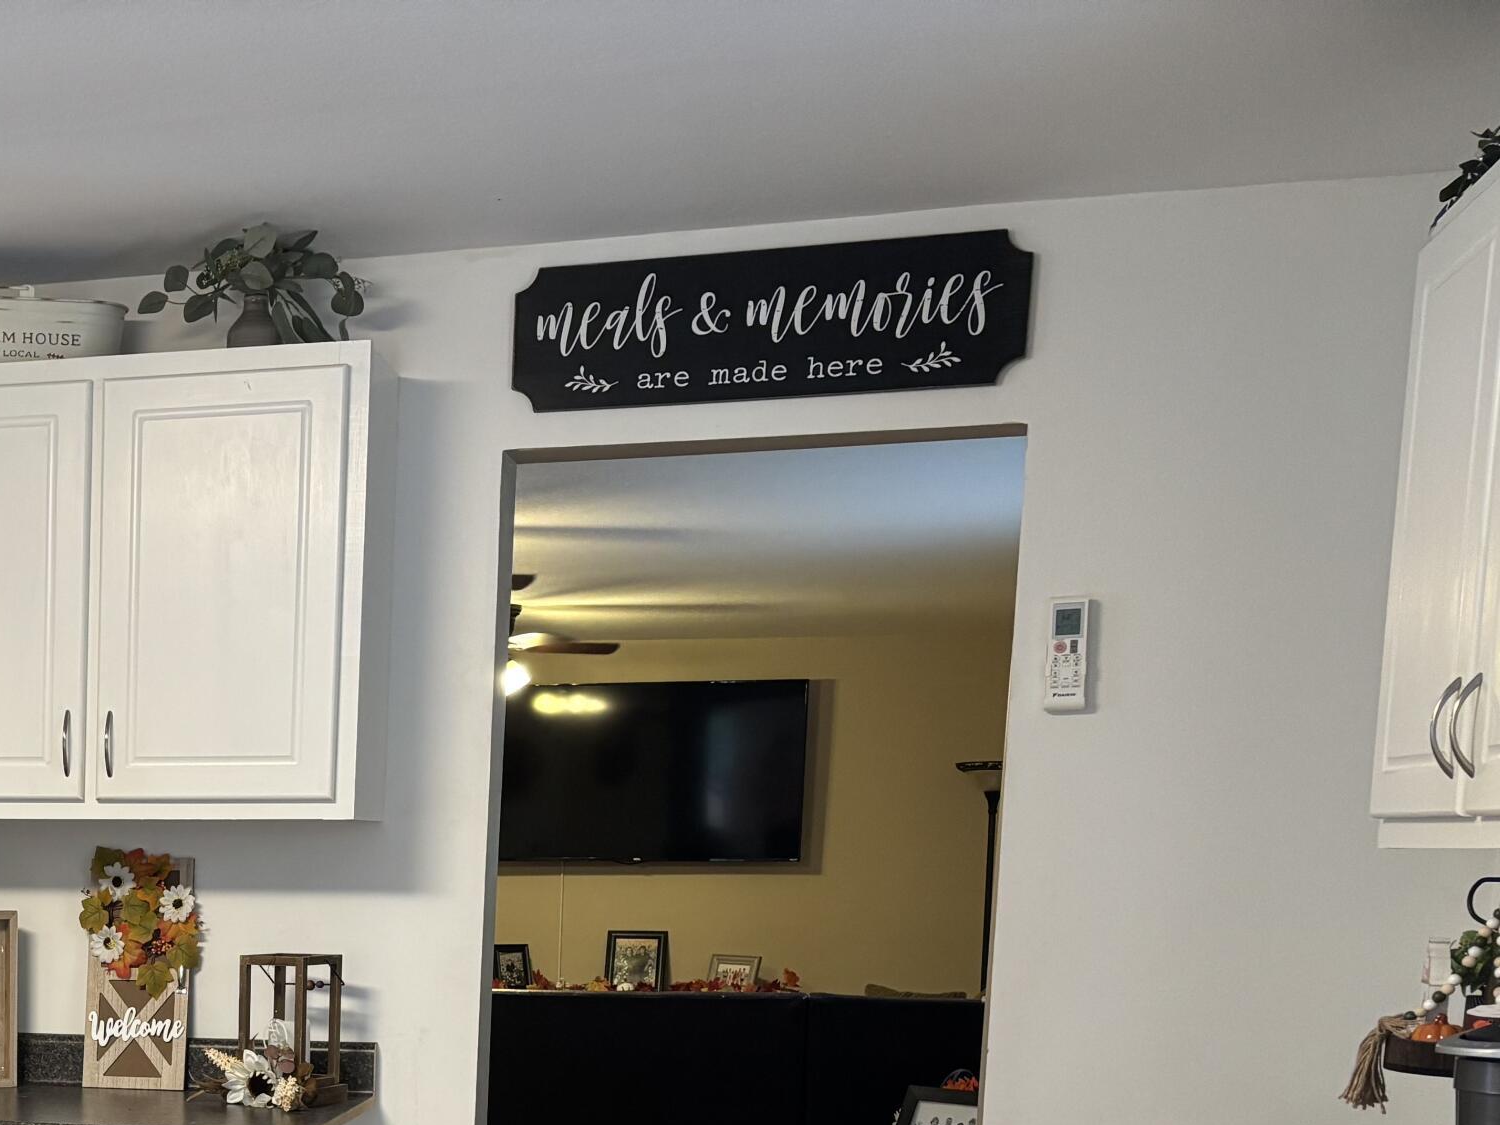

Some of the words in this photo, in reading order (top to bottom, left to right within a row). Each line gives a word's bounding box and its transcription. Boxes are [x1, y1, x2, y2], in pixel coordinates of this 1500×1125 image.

[536, 272, 684, 358] meals
[691, 291, 731, 335] &
[746, 270, 1004, 344] memories
[2, 349, 40, 359] LOCAL
[22, 332, 82, 347] HOUSE
[636, 369, 690, 389] are
[707, 360, 788, 386] made
[806, 356, 883, 379] here
[88, 1006, 185, 1047] Welcome
